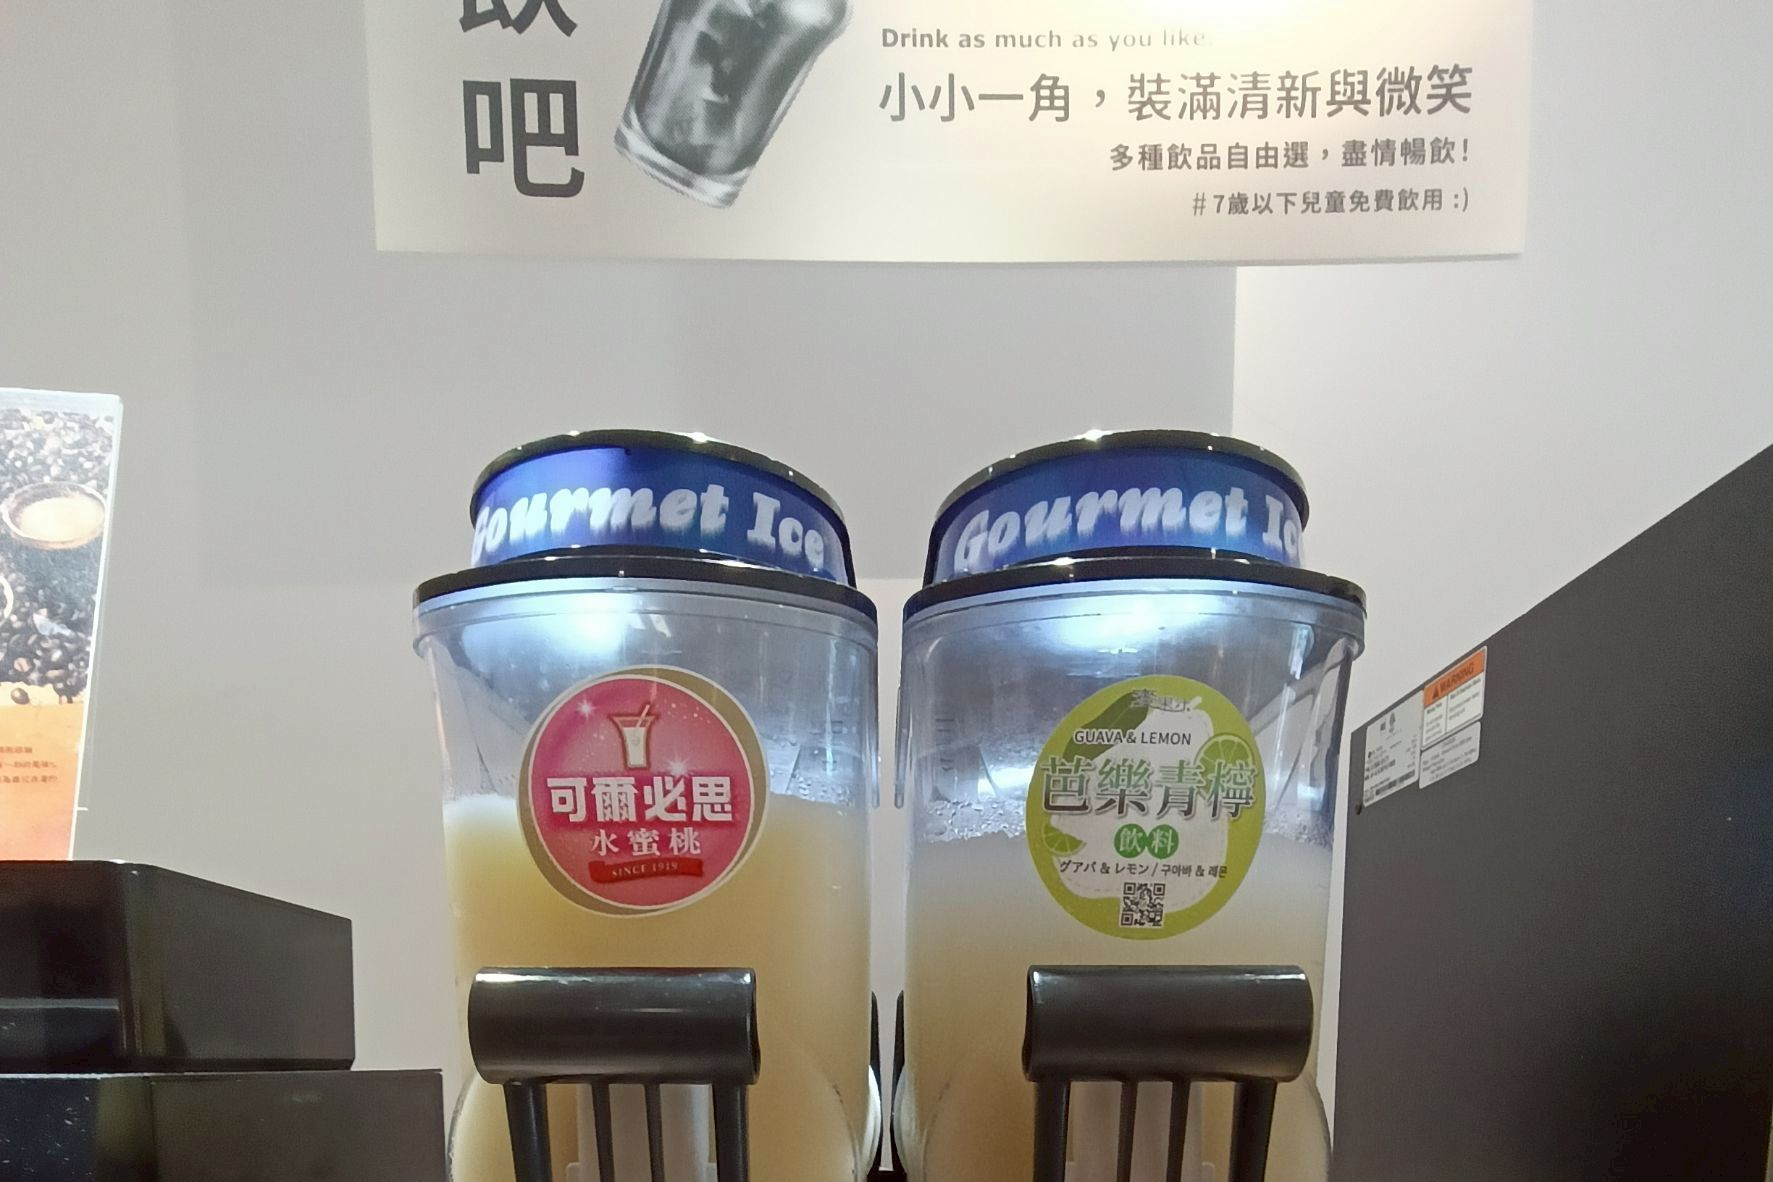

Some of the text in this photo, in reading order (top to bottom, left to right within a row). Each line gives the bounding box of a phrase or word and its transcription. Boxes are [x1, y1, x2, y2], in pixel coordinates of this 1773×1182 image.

[882, 28, 949, 47] Drink
[958, 32, 986, 48] as
[995, 29, 1062, 48] much
[1072, 32, 1098, 48] as
[1108, 30, 1152, 52] you
[879, 63, 1474, 123] 小小一角，裝滿清新與微笑
[746, 492, 825, 572] Ice
[954, 486, 1250, 573] Gourmet
[1074, 729, 1192, 746] GUAVA & LEMON
[546, 776, 734, 823] 可爾必思
[1040, 754, 1258, 821] 芭樂青檸
[590, 826, 702, 857] 水蜜桃
[1118, 827, 1176, 855] 飲料
[611, 864, 648, 878] SINCE
[1115, 862, 1149, 875] レモン
